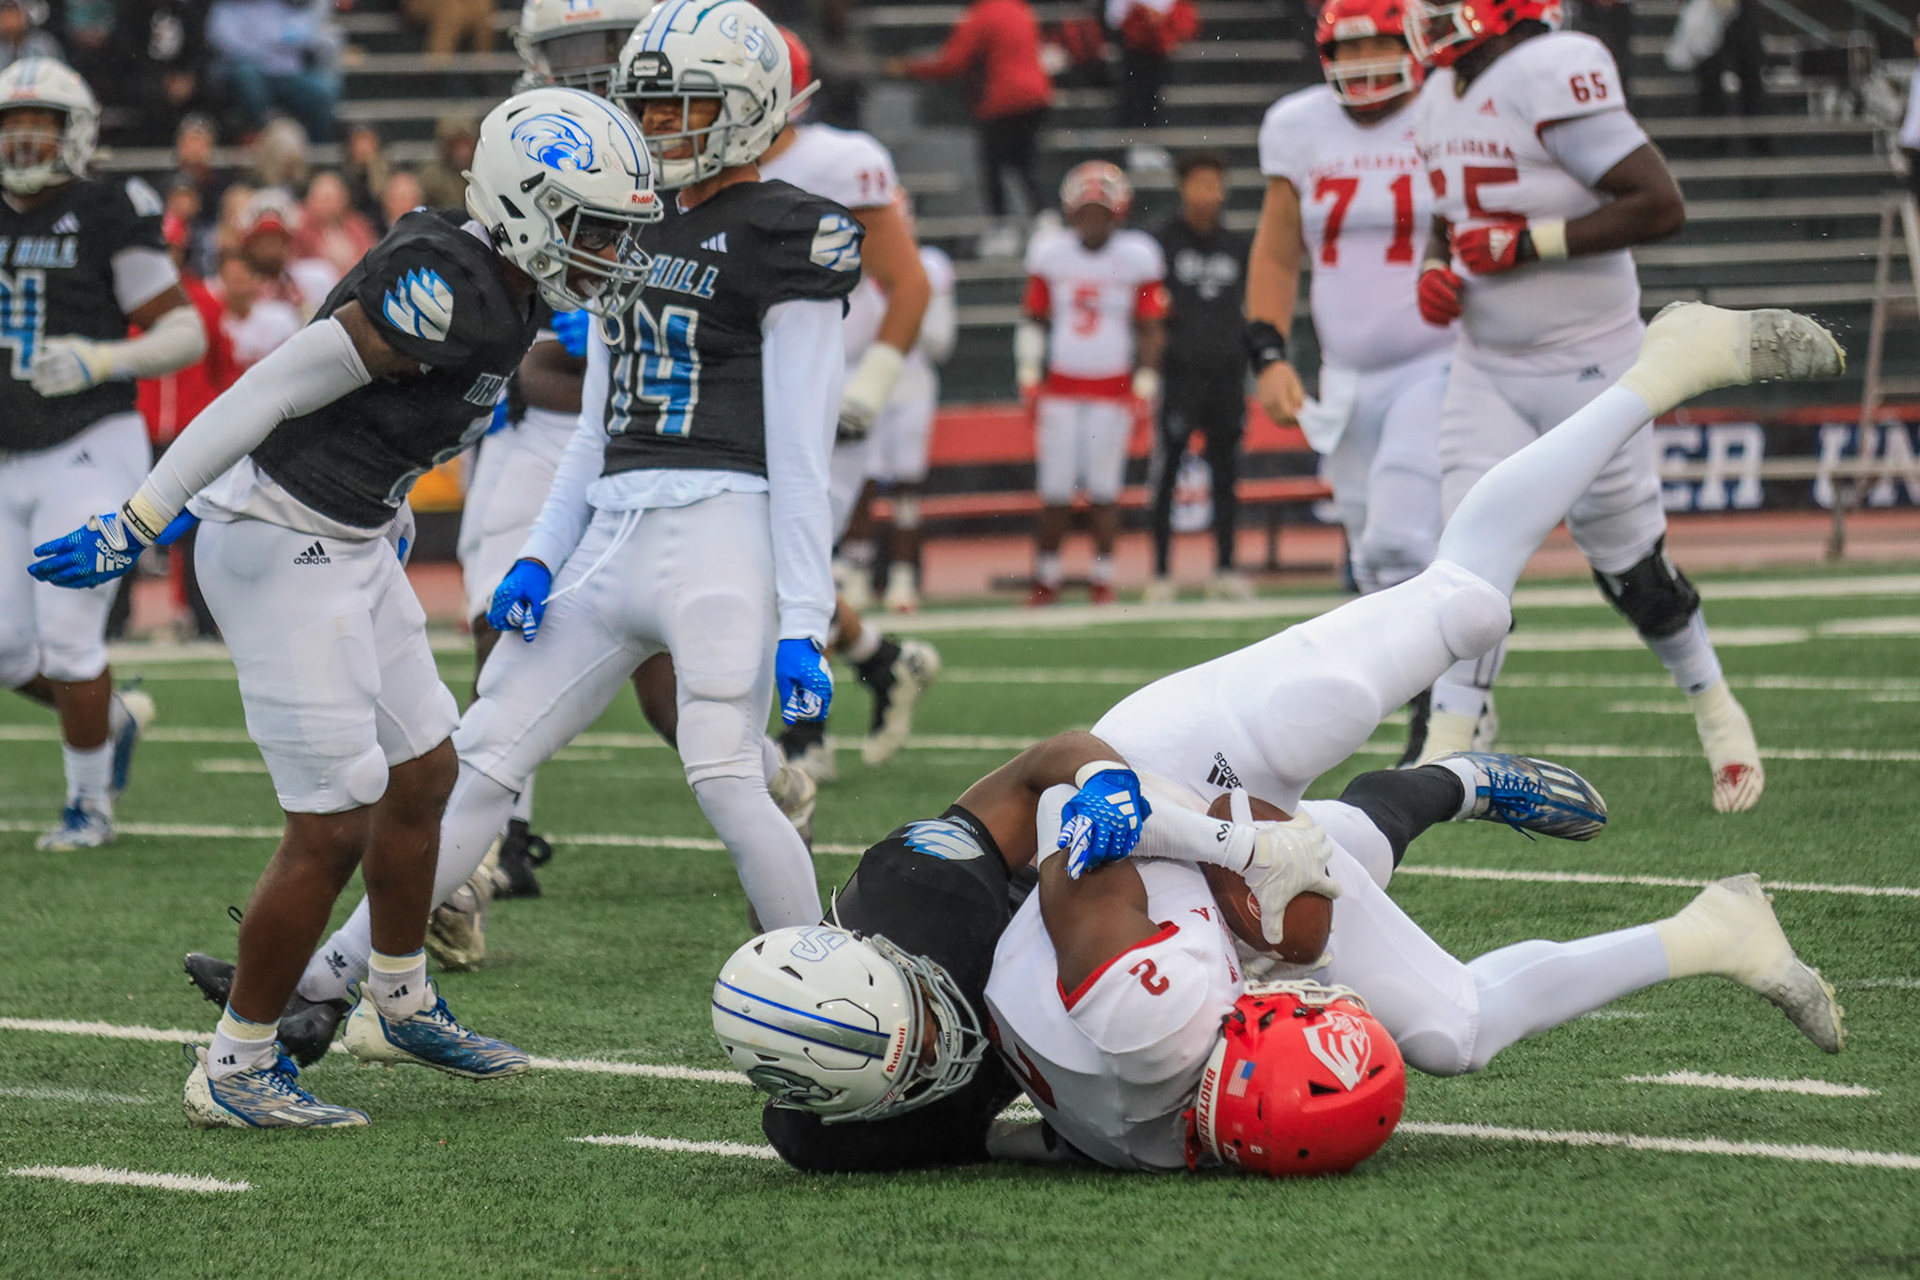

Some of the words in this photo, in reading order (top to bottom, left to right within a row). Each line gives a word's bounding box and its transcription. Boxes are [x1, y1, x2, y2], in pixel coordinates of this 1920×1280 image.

[1569, 71, 1608, 103] 65
[1312, 174, 1415, 266] 71
[12, 235, 79, 268] HILL
[646, 254, 719, 299] HILL
[603, 296, 702, 438] 14
[95, 538, 133, 565] adidas
[293, 556, 331, 565] adidas
[1128, 958, 1170, 996] 2
[886, 1027, 906, 1073] Riddell
[1250, 1144, 1263, 1155] 2
